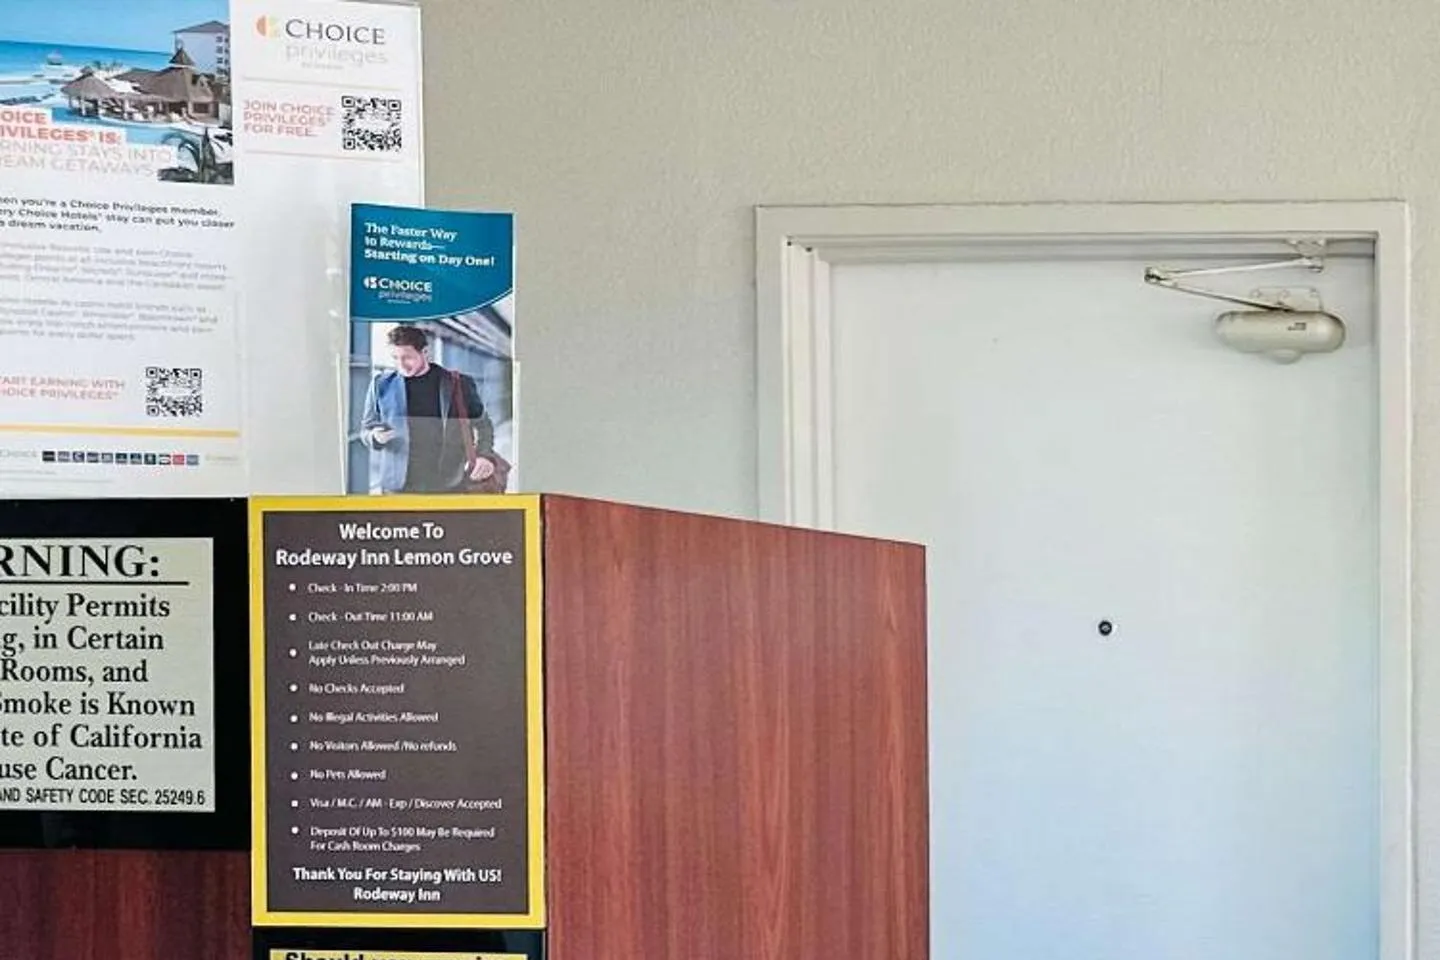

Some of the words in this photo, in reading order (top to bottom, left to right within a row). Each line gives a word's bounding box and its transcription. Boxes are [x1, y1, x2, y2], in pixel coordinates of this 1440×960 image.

[285, 19, 385, 45] CHOICE
[244, 100, 276, 111] JOIN
[280, 103, 334, 116] CHOICE
[244, 124, 275, 135] FOR
[364, 222, 388, 234] The
[391, 224, 429, 237] Faster
[430, 228, 457, 242] Way
[364, 237, 377, 246] to
[364, 249, 417, 264] Starting
[419, 254, 435, 264] on
[439, 255, 462, 267] Day
[465, 256, 495, 266] One!
[378, 277, 433, 292] CHOICE
[339, 523, 420, 540] Welcome
[422, 522, 444, 539] To
[276, 549, 358, 569] Rodeway
[360, 550, 390, 566] Inn
[395, 550, 454, 566] Lemon
[458, 549, 513, 565] Grove
[67, 592, 170, 617] Permits
[34, 625, 58, 650] in
[67, 625, 164, 650] Certain
[309, 656, 336, 666] Apply
[339, 655, 369, 665] Unless
[371, 655, 419, 667] Previously
[420, 654, 466, 667] Arranged
[1, 659, 94, 686] Rooms,
[102, 659, 148, 682] and
[0, 691, 72, 715] moke
[80, 692, 99, 714] is
[107, 691, 195, 716] Known
[33, 723, 62, 748] of
[70, 723, 202, 749] California
[46, 756, 138, 780] Cancer.
[310, 769, 324, 779] No
[326, 769, 345, 779] Pets
[347, 769, 387, 780] Allowed
[310, 827, 346, 838] Deposit
[349, 827, 360, 837] Of
[363, 827, 376, 838] Up
[417, 827, 436, 839] May
[452, 827, 495, 839] Required
[311, 841, 326, 851] For
[328, 841, 350, 851] Cash
[353, 841, 381, 851] Room
[382, 841, 421, 852] Charges
[293, 867, 335, 881] Thank
[337, 868, 362, 881] You
[365, 868, 389, 881] For
[391, 867, 442, 884] Staying
[443, 867, 475, 882] With
[479, 868, 502, 883] US!
[354, 887, 415, 903] Rodeway
[418, 888, 441, 901] Inn
